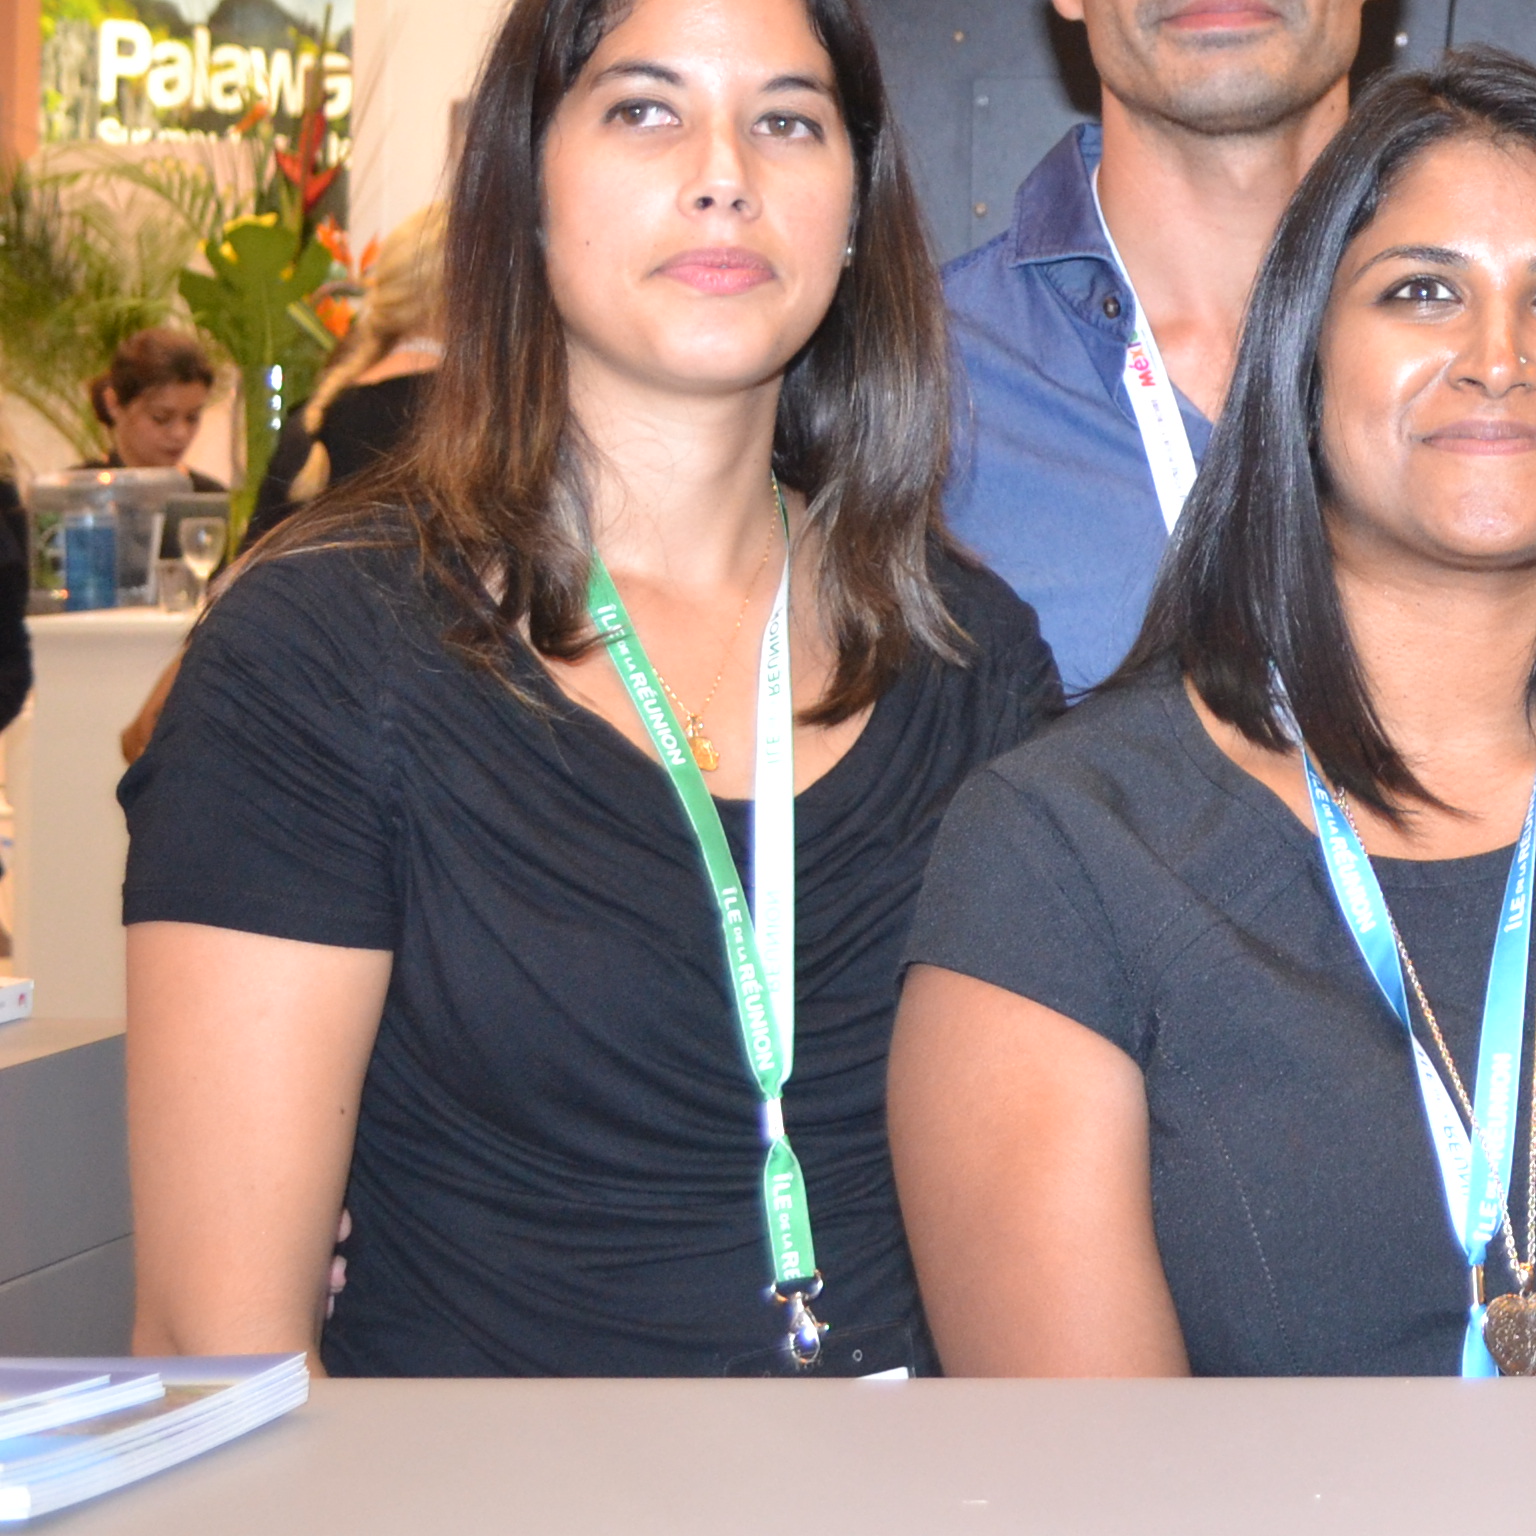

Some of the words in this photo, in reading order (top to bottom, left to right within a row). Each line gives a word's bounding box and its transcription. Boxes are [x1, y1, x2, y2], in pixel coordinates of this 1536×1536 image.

[628, 669, 688, 767] RÉUNION
[1329, 836, 1377, 934] RÉUNION
[722, 885, 744, 926] ÎLE
[738, 961, 774, 1072] RÉUNION
[773, 1173, 793, 1211] ÎLE
